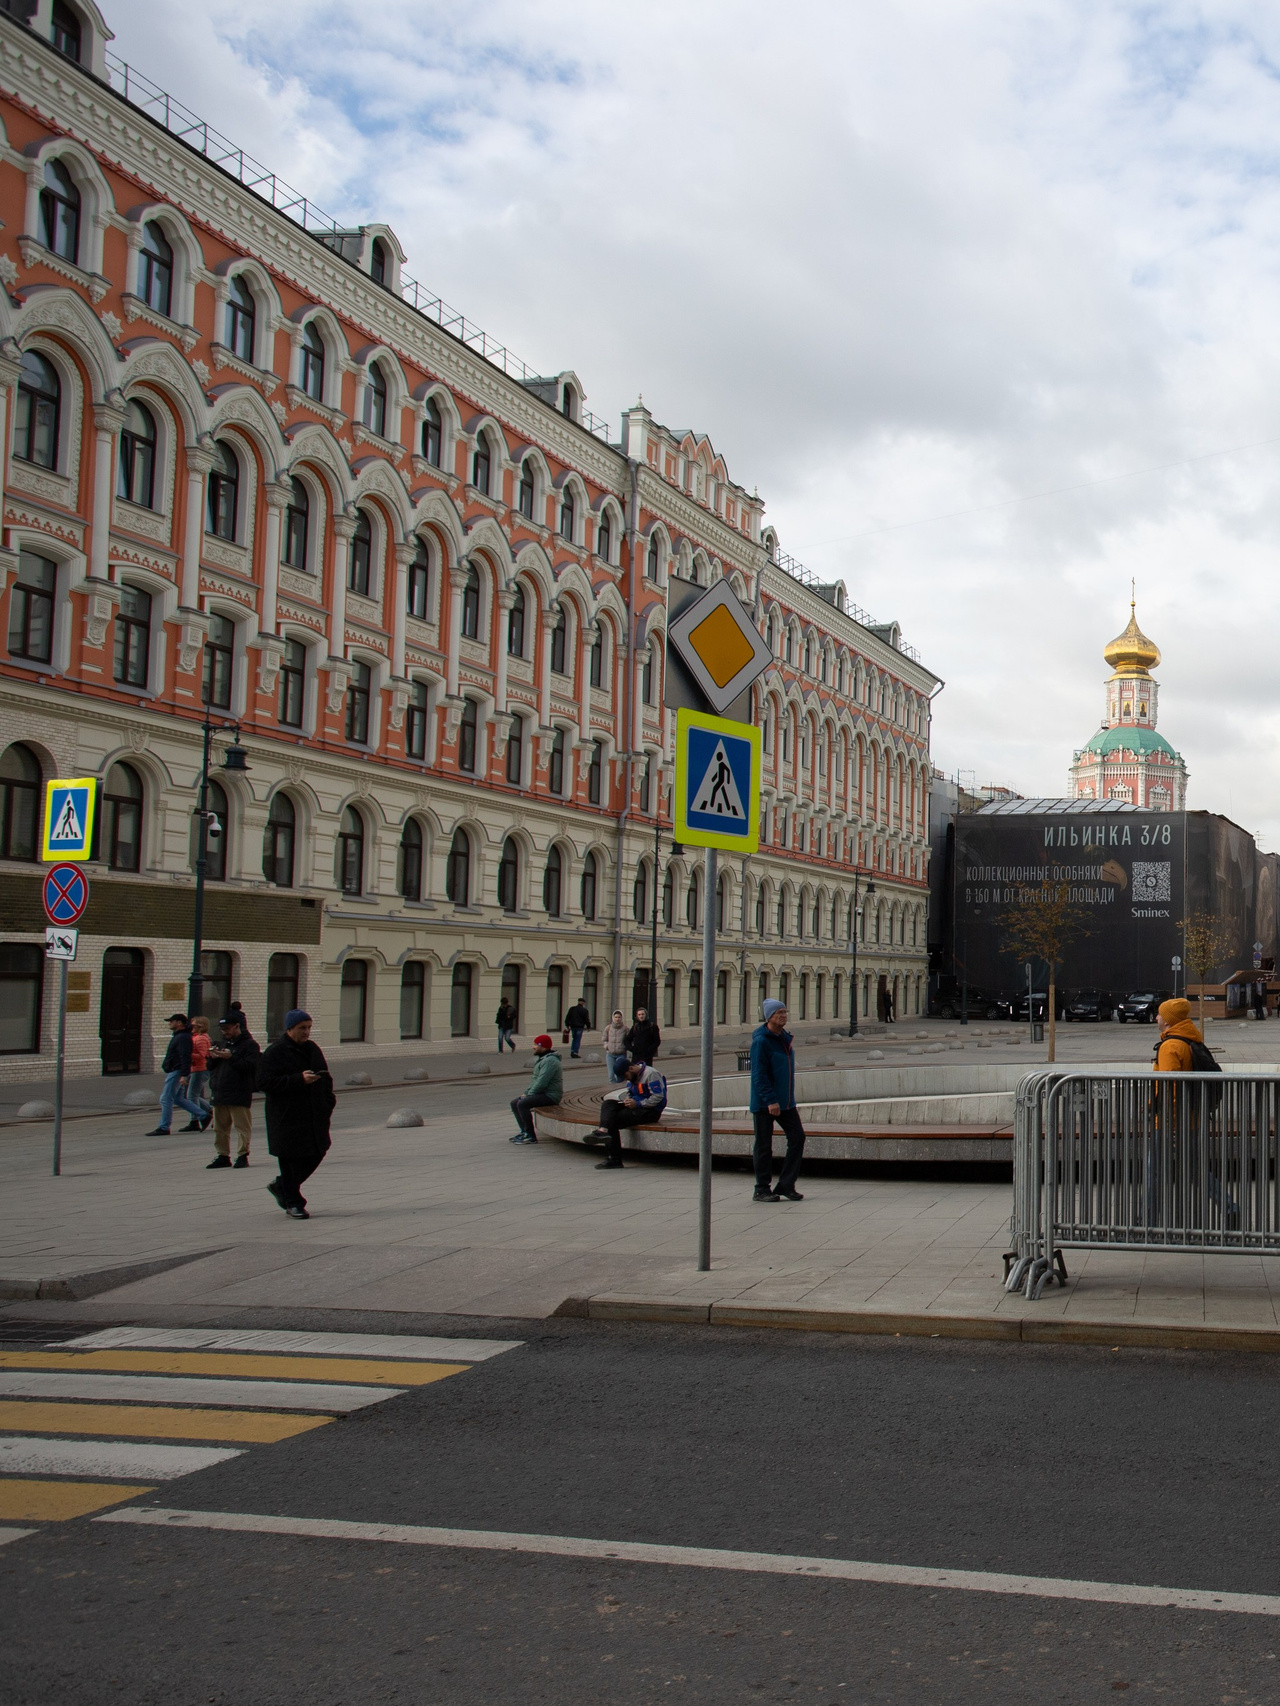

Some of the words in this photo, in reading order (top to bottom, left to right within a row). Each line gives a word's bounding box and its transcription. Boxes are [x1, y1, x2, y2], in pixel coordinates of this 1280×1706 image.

[1044, 825, 1131, 847] ИЛЬИНКА
[1141, 824, 1171, 846] 3/8
[966, 865, 1049, 883] КОЛЛЕКЦИОННЫЕ
[1053, 865, 1103, 881] ОСОБНЯКИ
[974, 889, 989, 903] 160
[992, 889, 1000, 902] М
[1004, 888, 1015, 902] ОТ
[1131, 907, 1170, 918] Sminex
